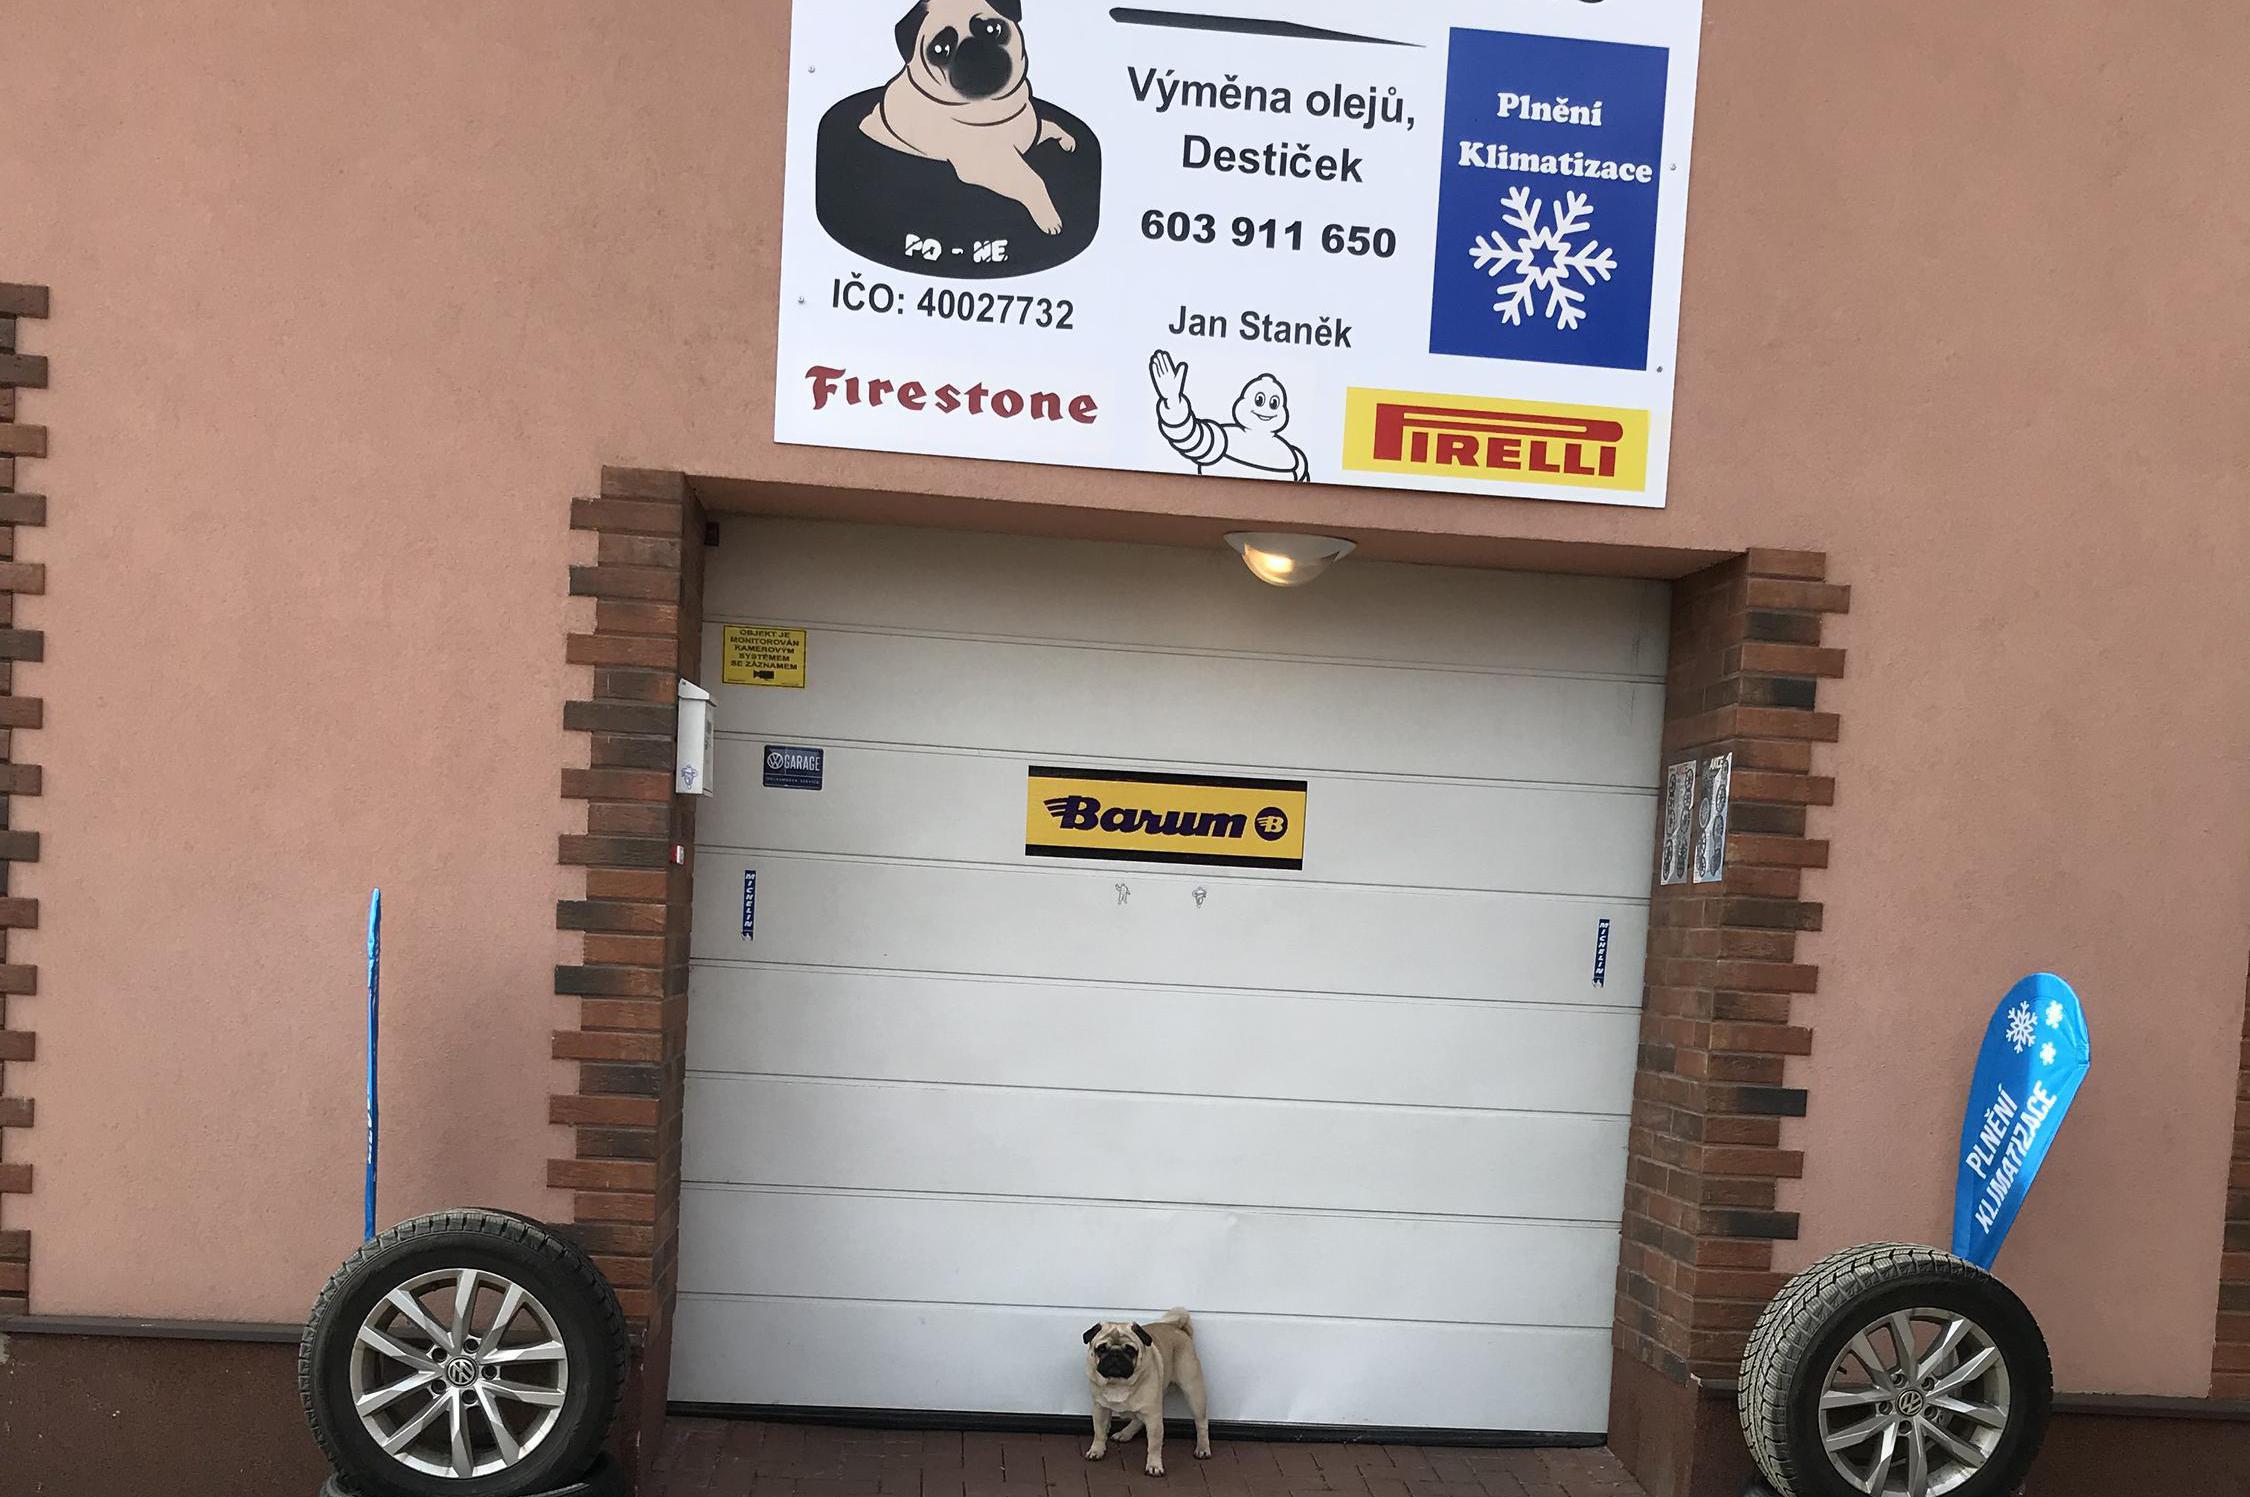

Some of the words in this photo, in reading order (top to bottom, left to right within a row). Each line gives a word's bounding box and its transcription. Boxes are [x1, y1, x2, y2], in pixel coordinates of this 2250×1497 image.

[1127, 66, 1292, 113] Výměna
[1306, 83, 1415, 131] olejů,
[1497, 91, 1603, 127] Plnění
[1182, 134, 1363, 183] Destiček
[1458, 141, 1653, 183] Klimatizace
[1141, 209, 1216, 244] 603
[1231, 216, 1302, 251] 911
[1321, 223, 1397, 259] 650
[832, 272, 904, 315] IČO:
[917, 287, 1074, 330] 40027732
[1169, 305, 1227, 338] Jan
[1239, 309, 1352, 349] Staněk
[805, 365, 1098, 424] Firestone
[1373, 403, 1623, 477] PIRELLI
[730, 636, 800, 646] MONITOROVÁN
[735, 644, 795, 654] KAMEROVÝM
[740, 629, 777, 638] OBJEKT
[739, 653, 790, 662] SYSTÉMEM
[745, 660, 798, 670] ZÁZNAMEM
[784, 754, 821, 771] GARAGE
[1043, 795, 1247, 838] Barum
[744, 873, 756, 927] MICHELIN
[1595, 922, 1609, 974] MICHELIN
[1965, 1083, 2018, 1179] PLNĚNÍ
[1974, 1080, 2057, 1234] KLIMATIZACE
